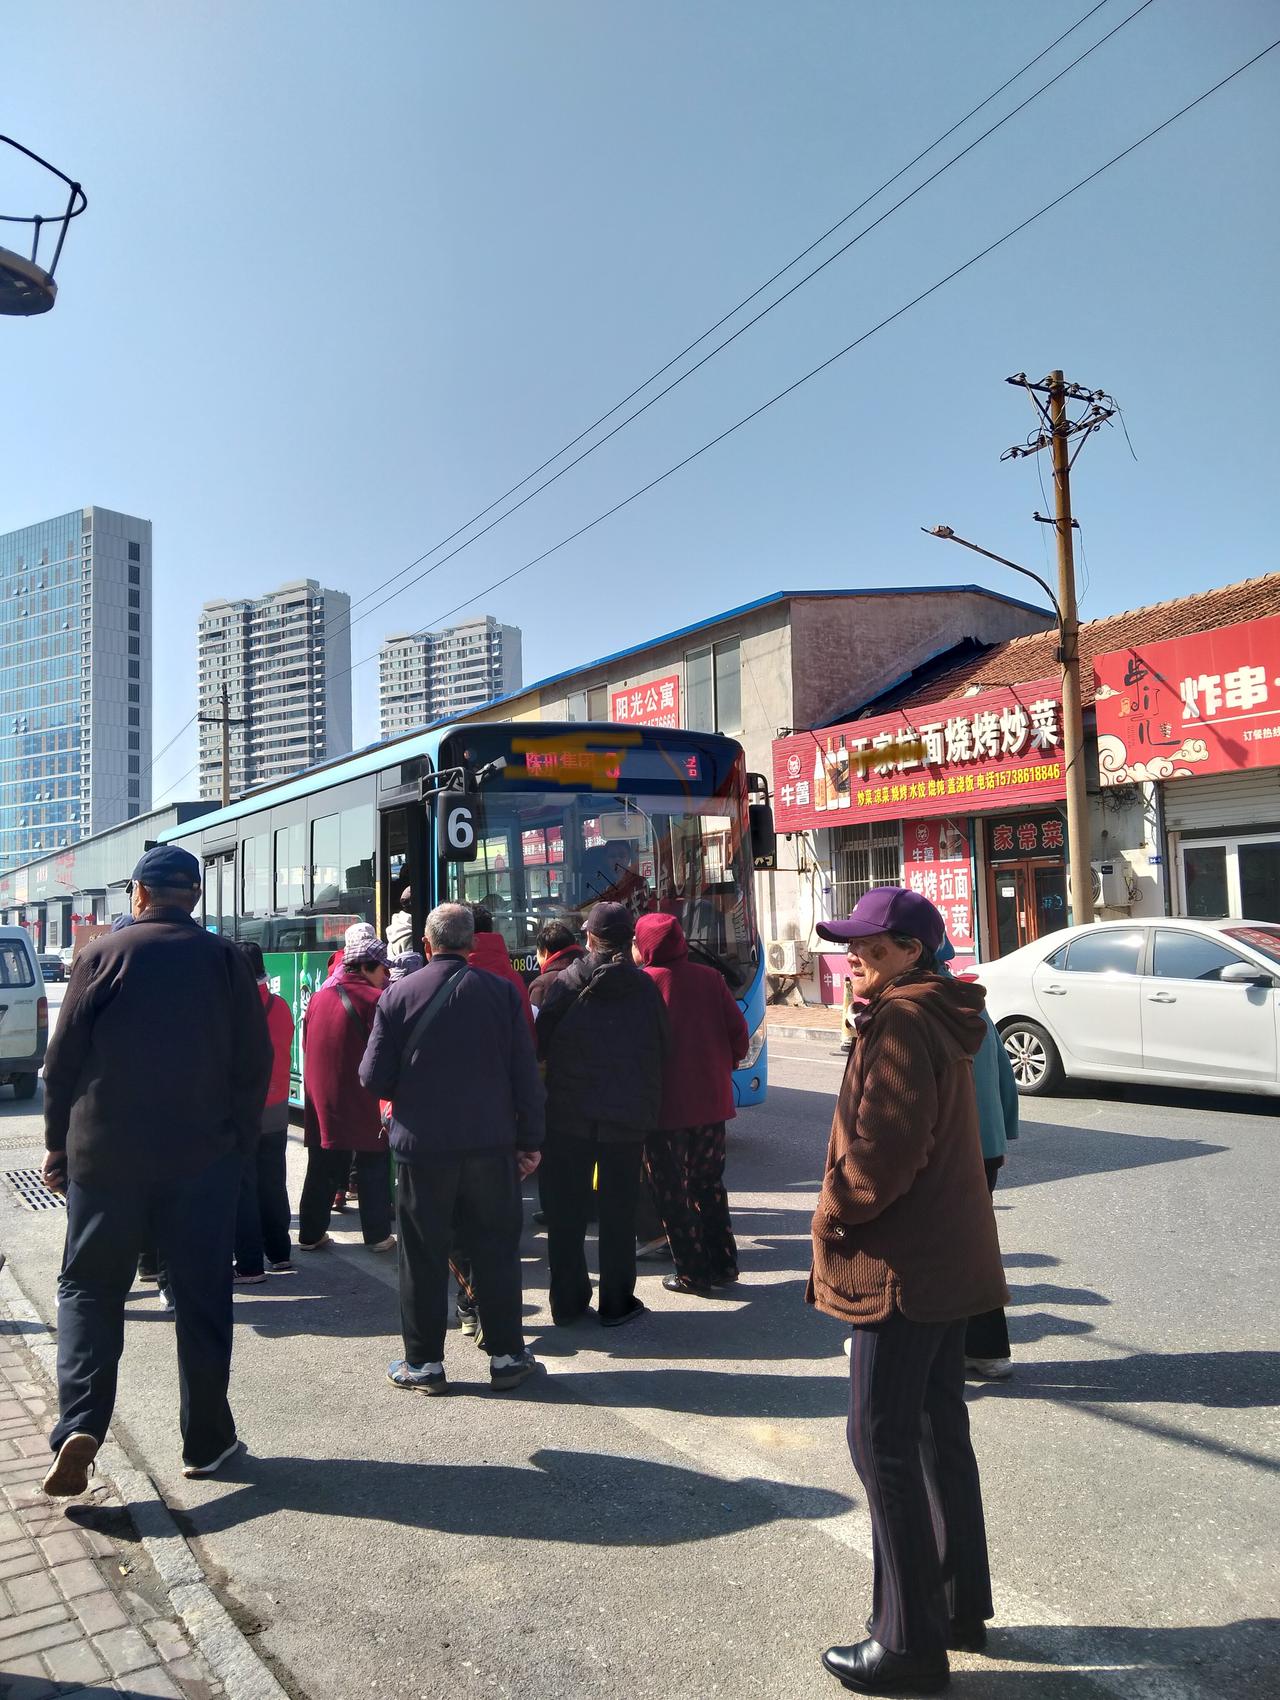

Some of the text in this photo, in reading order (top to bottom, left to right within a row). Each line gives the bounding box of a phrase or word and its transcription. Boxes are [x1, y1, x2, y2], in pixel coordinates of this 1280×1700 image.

[615, 682, 674, 721] 阳光公寓
[856, 788, 873, 807] 炒菜
[874, 786, 890, 804] 凉菜
[891, 784, 908, 802] 烧烤
[909, 782, 926, 799] 水饺
[947, 774, 974, 795] 盖浇饭
[447, 807, 474, 849] 6
[993, 820, 1064, 851] 家常菜
